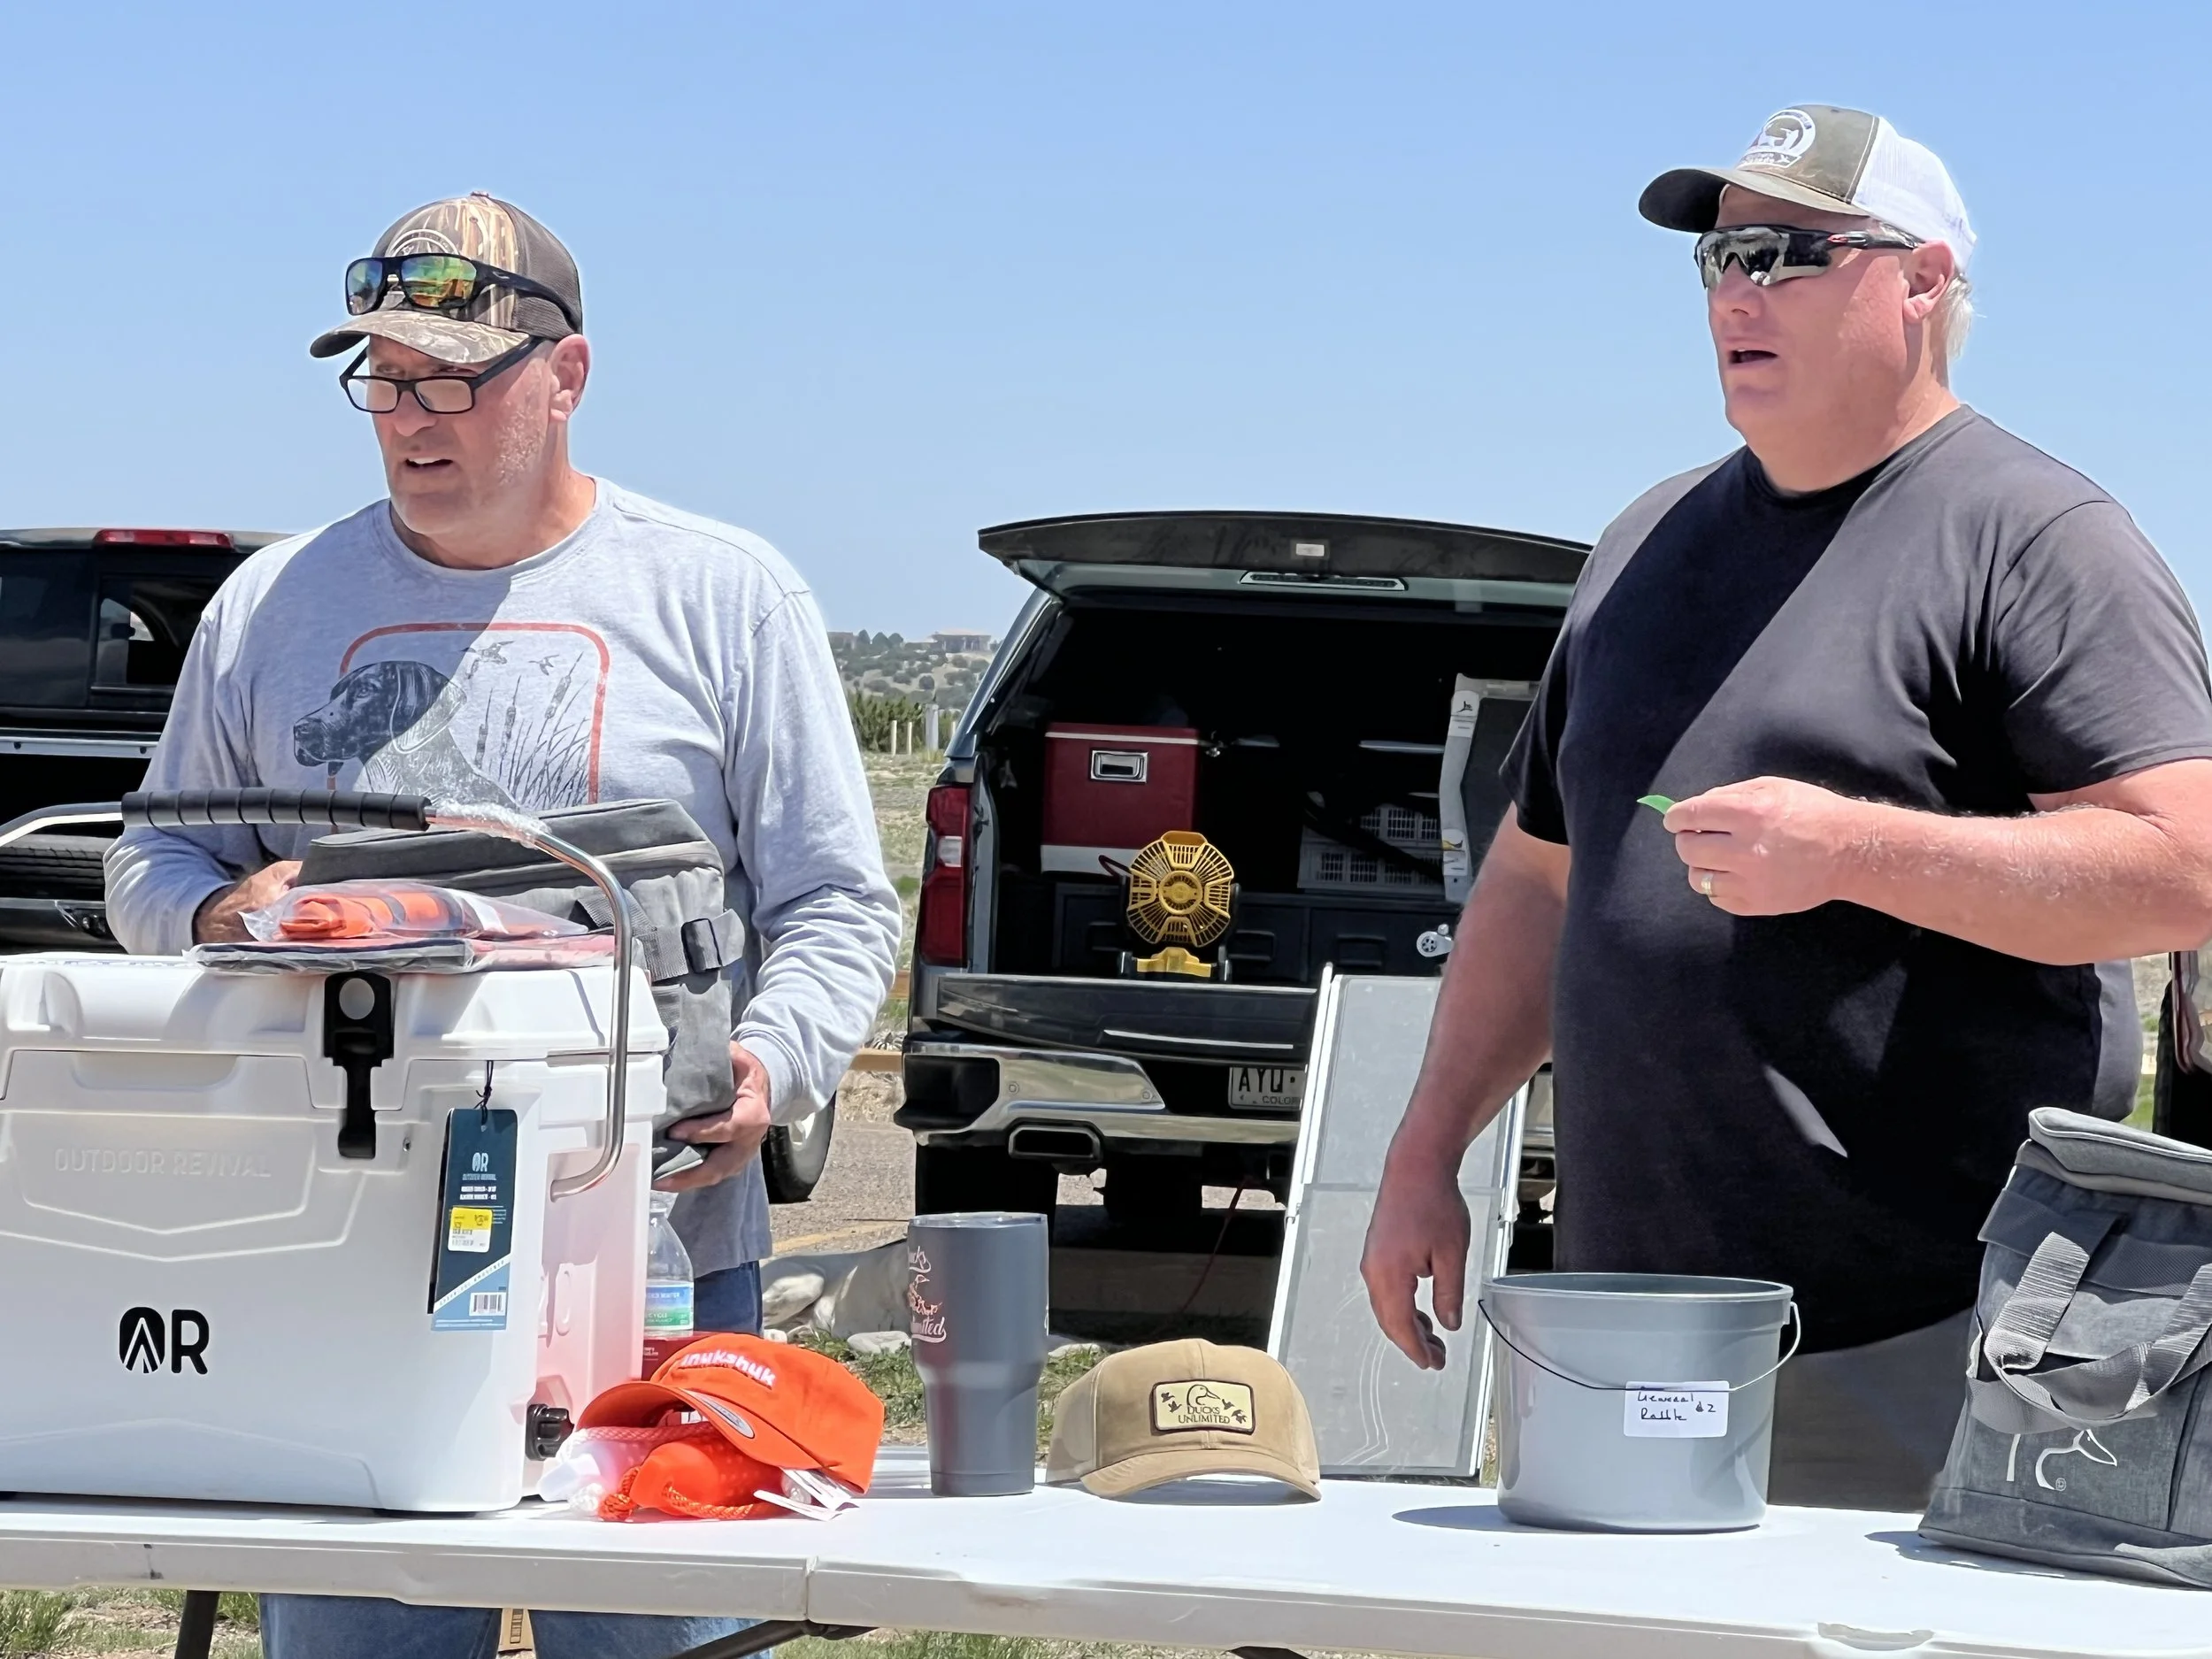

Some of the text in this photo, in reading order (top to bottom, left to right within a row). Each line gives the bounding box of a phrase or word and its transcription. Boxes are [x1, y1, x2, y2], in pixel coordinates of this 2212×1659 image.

[55, 1148, 272, 1178] OUTDOOR REVIVAL
[1187, 1406, 1220, 1415] DUCKS
[1178, 1414, 1231, 1425] UNLIMITED
